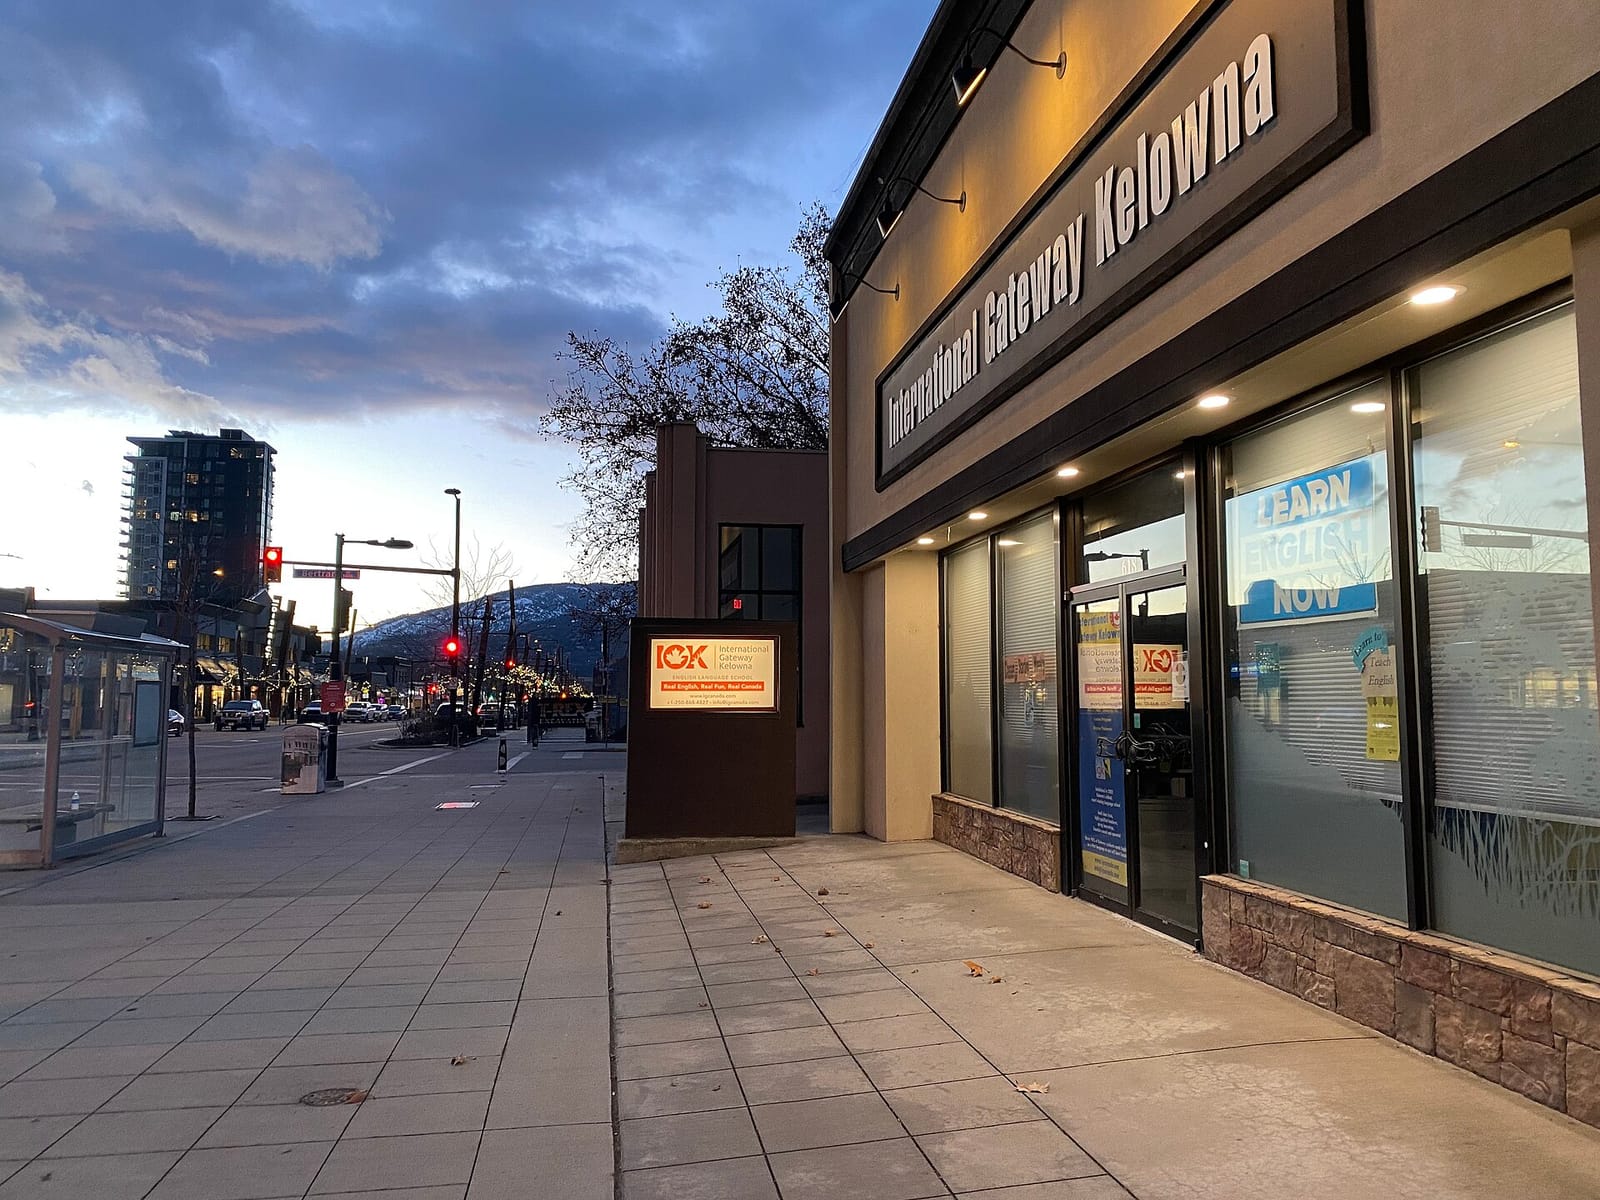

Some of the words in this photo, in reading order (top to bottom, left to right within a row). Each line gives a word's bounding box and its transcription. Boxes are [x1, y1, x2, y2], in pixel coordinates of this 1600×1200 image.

[889, 309, 978, 449] International
[984, 213, 1085, 365] Gateway
[1095, 33, 1274, 267] Kelowna
[1256, 471, 1350, 528] LEARN
[1245, 515, 1369, 573] ENGLISH
[1273, 573, 1342, 615] NOW
[719, 645, 769, 653] International
[1354, 639, 1373, 657] Learn
[1373, 632, 1382, 642] to
[656, 645, 708, 669] IGK
[719, 654, 753, 662] Gateway
[719, 662, 753, 670] Kelowna
[1370, 657, 1391, 668] Teach
[1368, 674, 1394, 688] English
